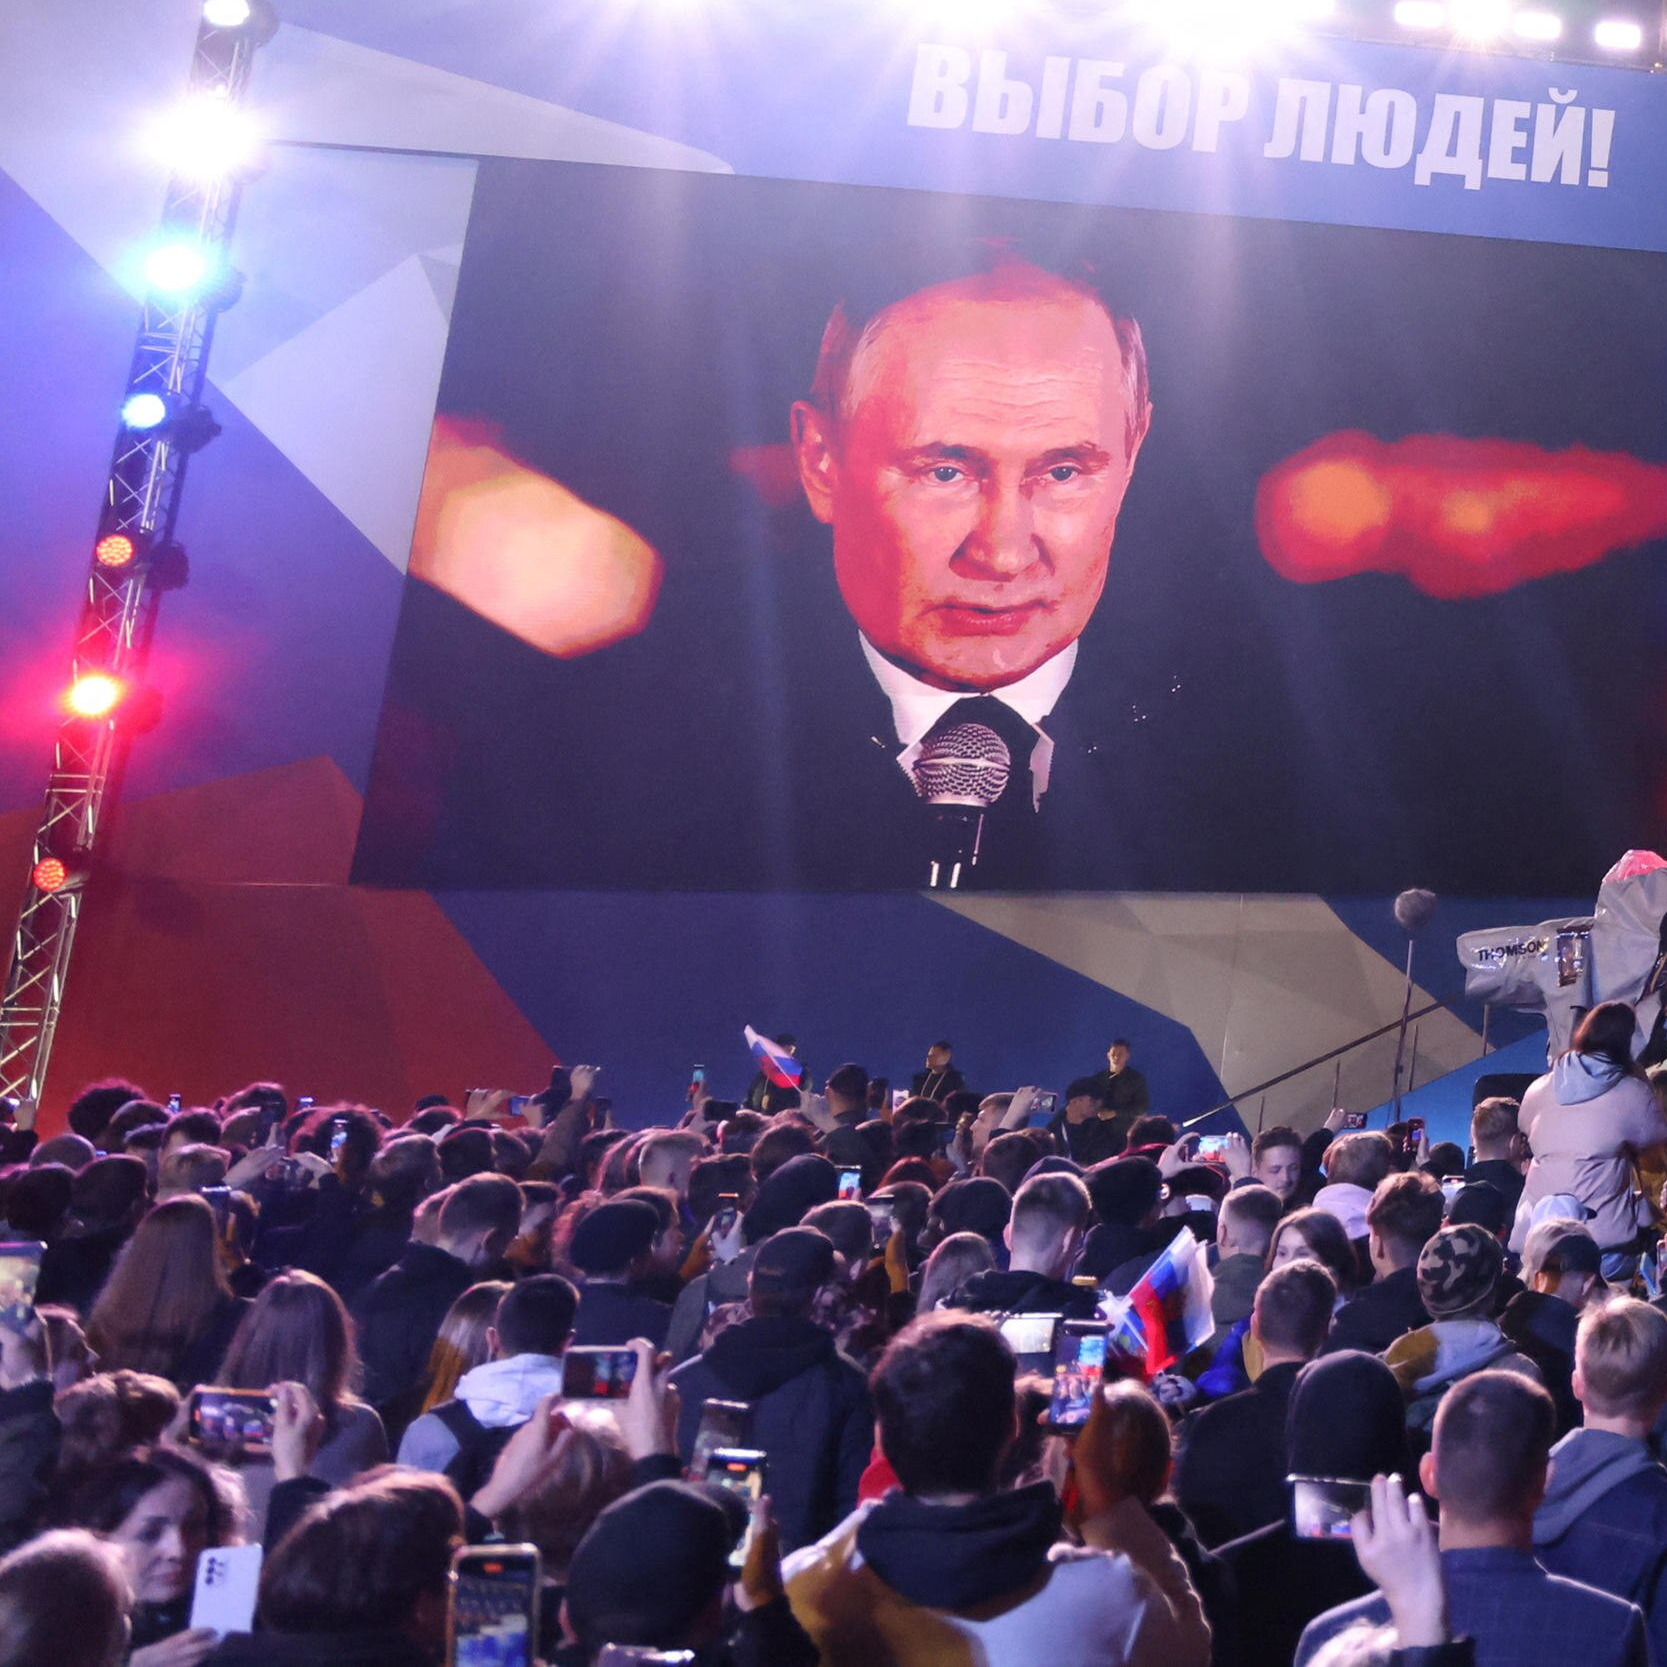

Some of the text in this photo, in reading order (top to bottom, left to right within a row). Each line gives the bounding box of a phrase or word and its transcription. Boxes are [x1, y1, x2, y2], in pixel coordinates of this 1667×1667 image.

[906, 41, 1616, 191] ВЫБОР ЛЮДЕЙ!
[1478, 940, 1545, 961] THOMSON
